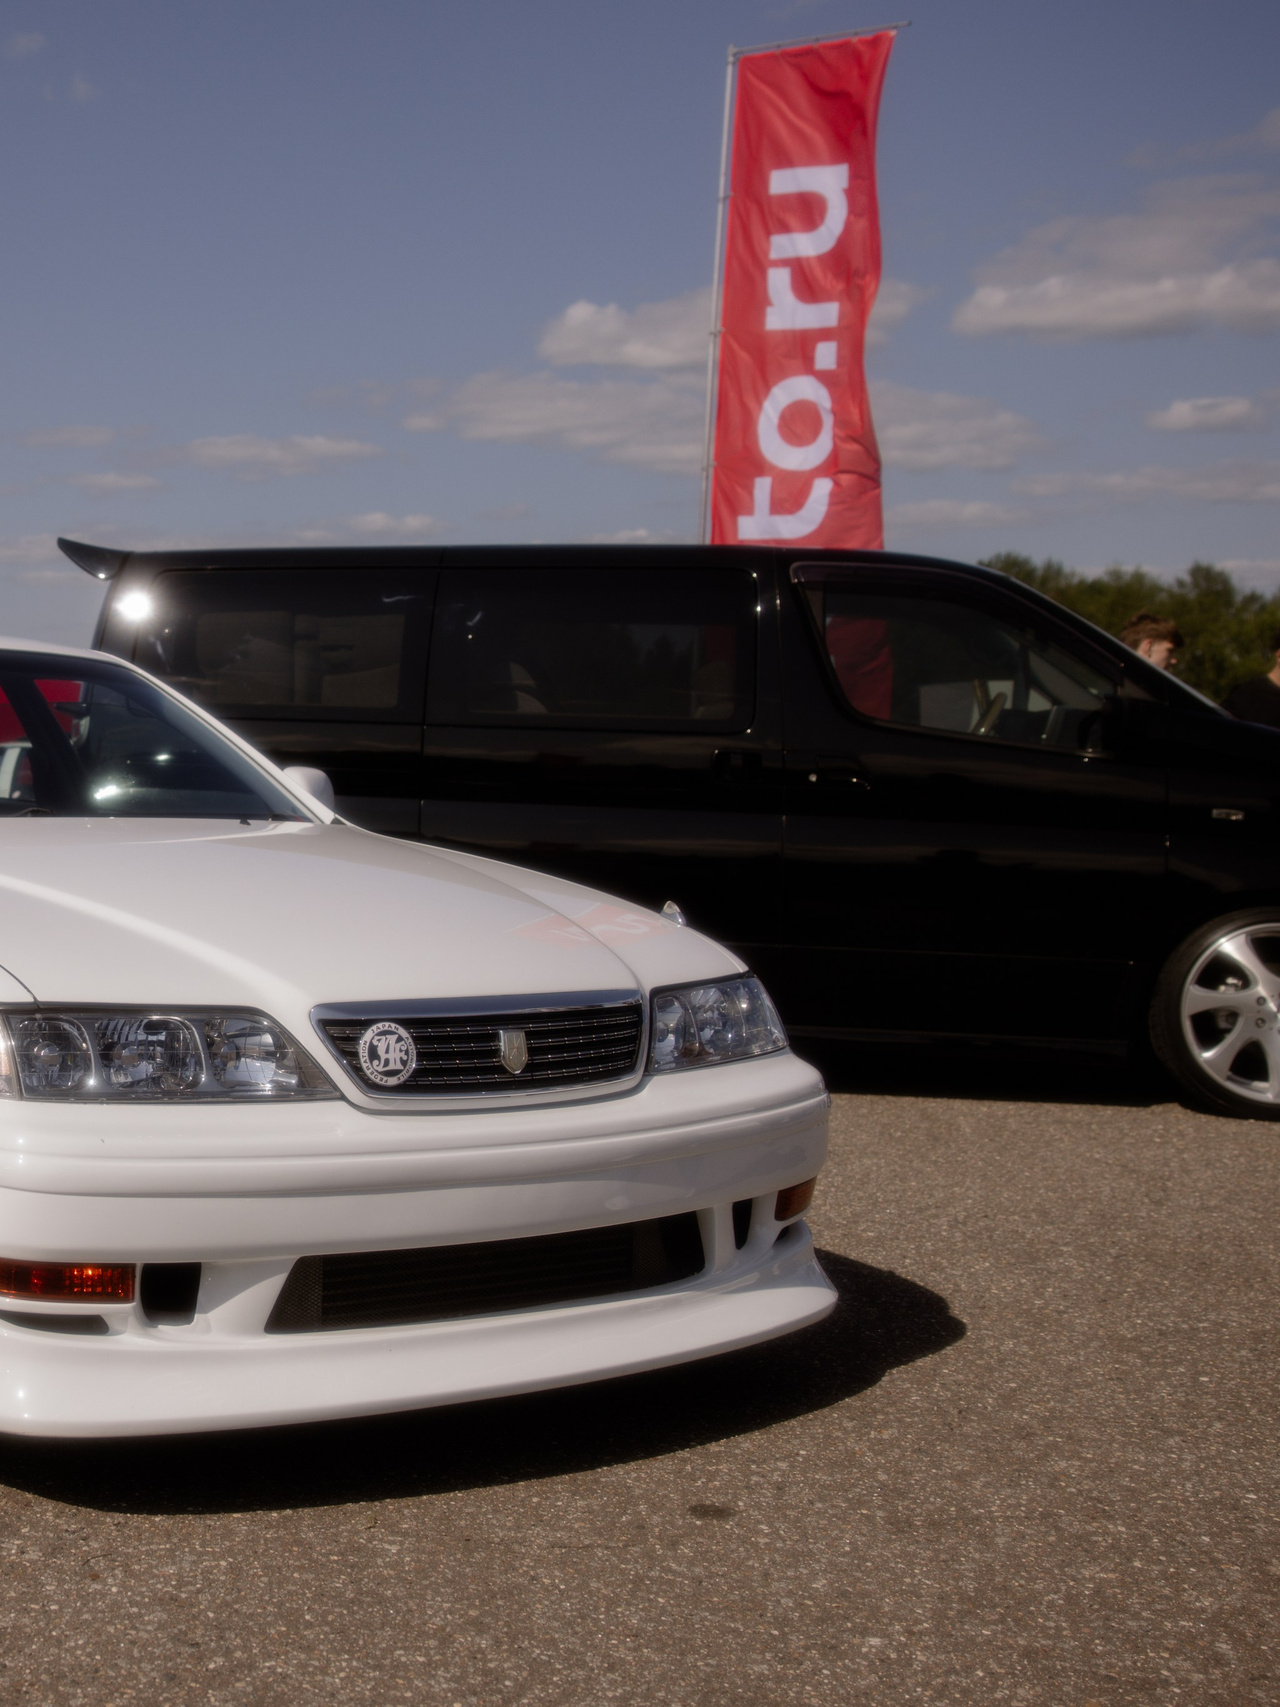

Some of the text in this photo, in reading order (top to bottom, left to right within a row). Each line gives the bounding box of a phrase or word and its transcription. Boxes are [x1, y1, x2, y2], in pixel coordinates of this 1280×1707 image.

[361, 1023, 415, 1084] JAPAN AUTOMOBILE FEDERATION
